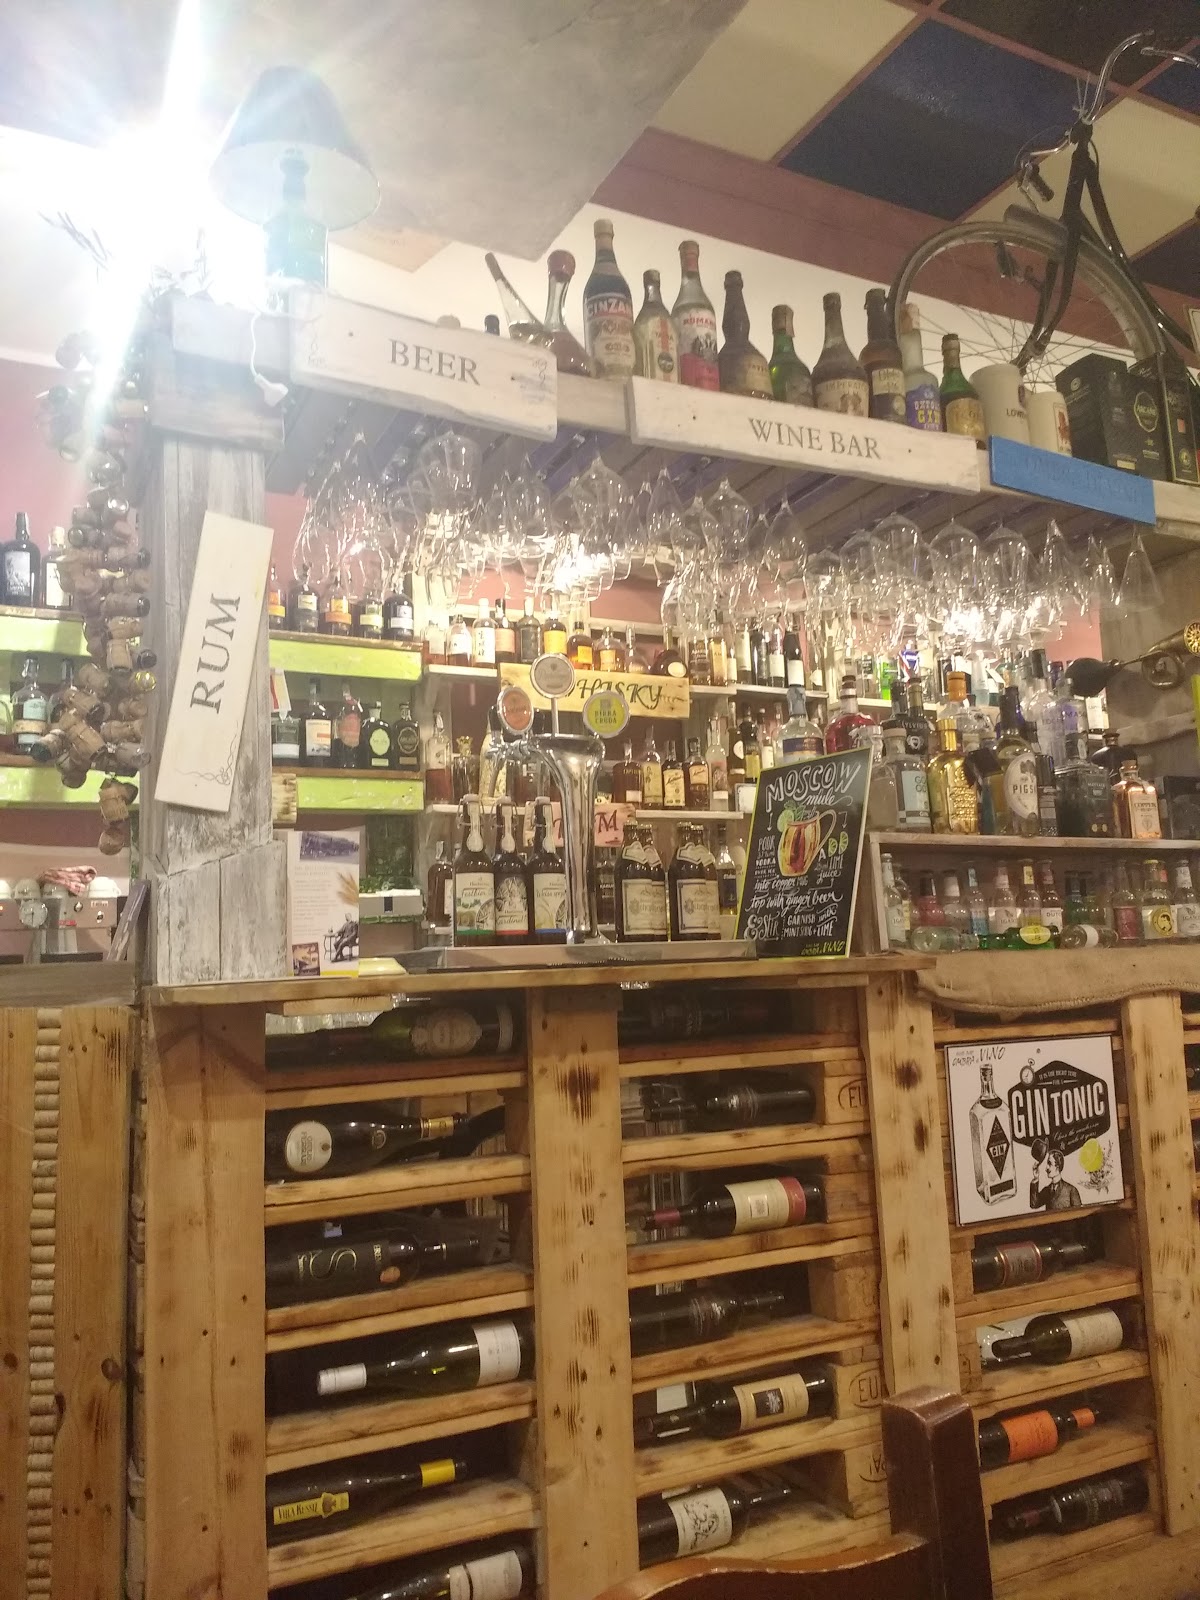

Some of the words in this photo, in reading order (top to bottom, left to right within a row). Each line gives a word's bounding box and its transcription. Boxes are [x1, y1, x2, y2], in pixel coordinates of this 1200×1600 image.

[388, 338, 480, 386] BEER
[748, 417, 823, 451] WINE
[830, 430, 881, 459] BAR
[190, 592, 241, 714] RUM
[765, 762, 861, 813] MOSCOW
[980, 1045, 1006, 1062] VINO
[991, 1145, 1005, 1156] GIN
